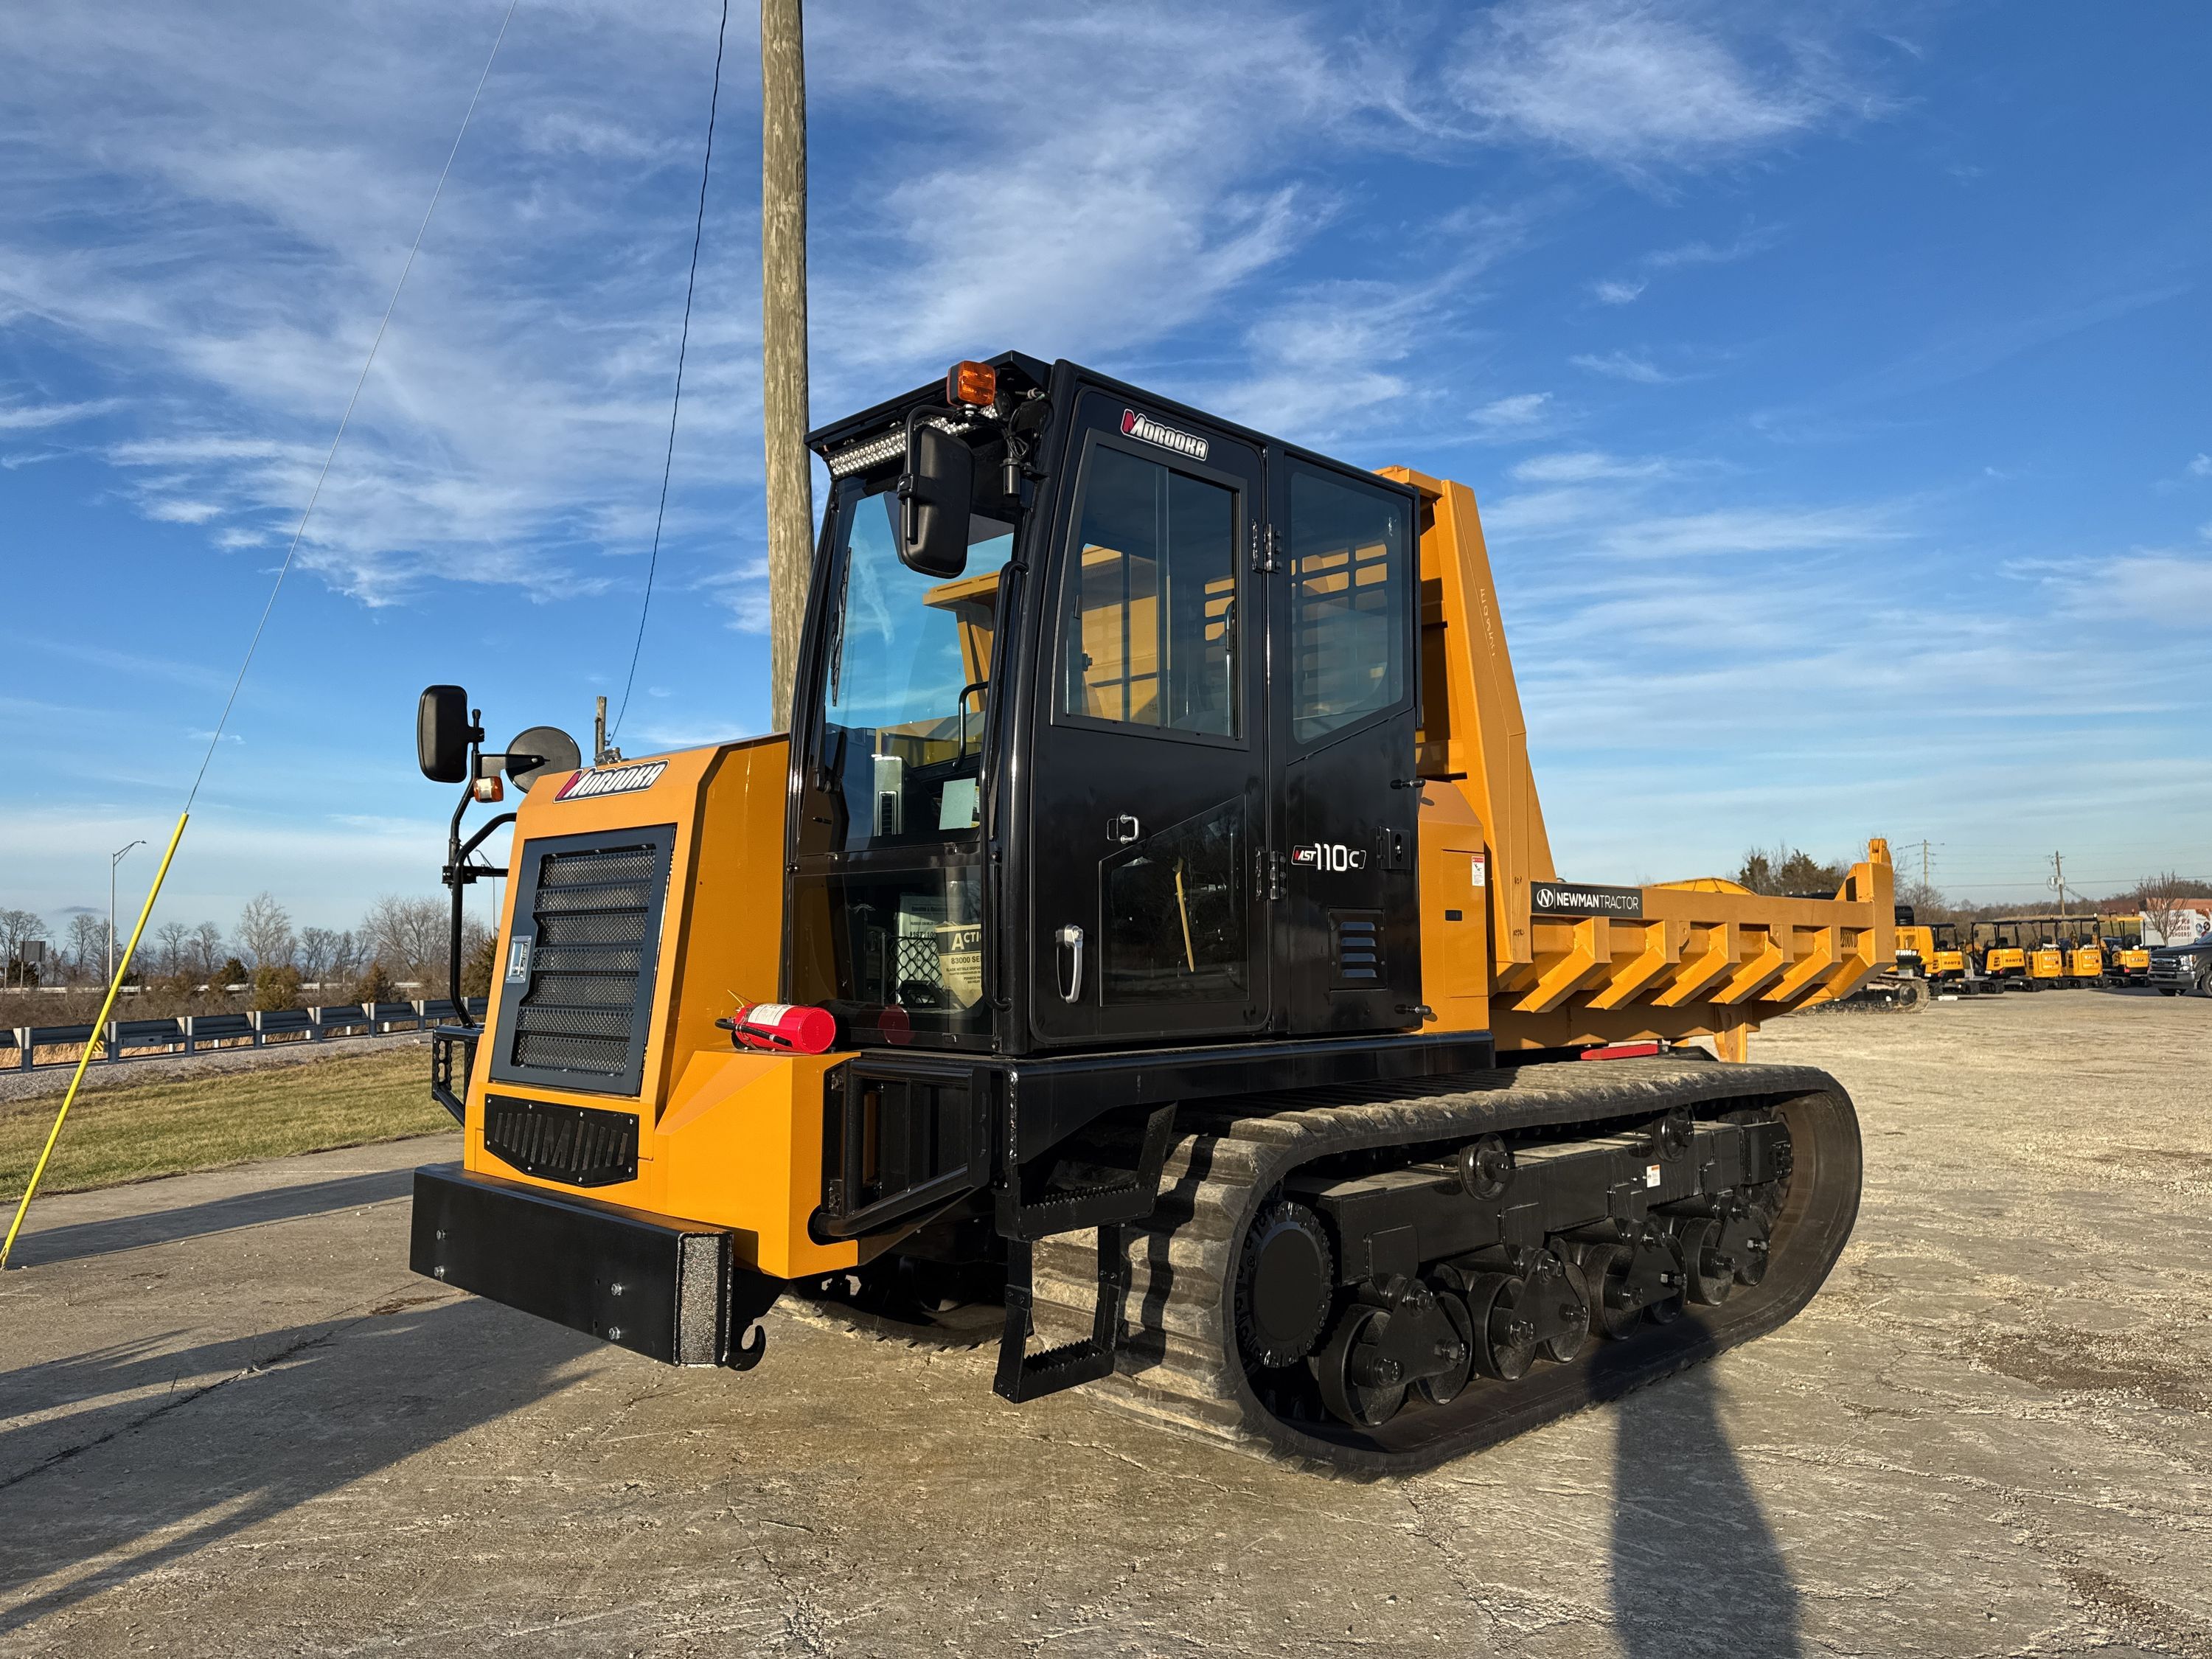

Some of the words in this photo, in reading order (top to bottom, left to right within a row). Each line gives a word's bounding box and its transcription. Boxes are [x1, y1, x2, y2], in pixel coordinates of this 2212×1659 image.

[1121, 410, 1207, 458] MOROOKA
[556, 762, 666, 799] MOROOKA
[951, 932, 981, 950] ACTI
